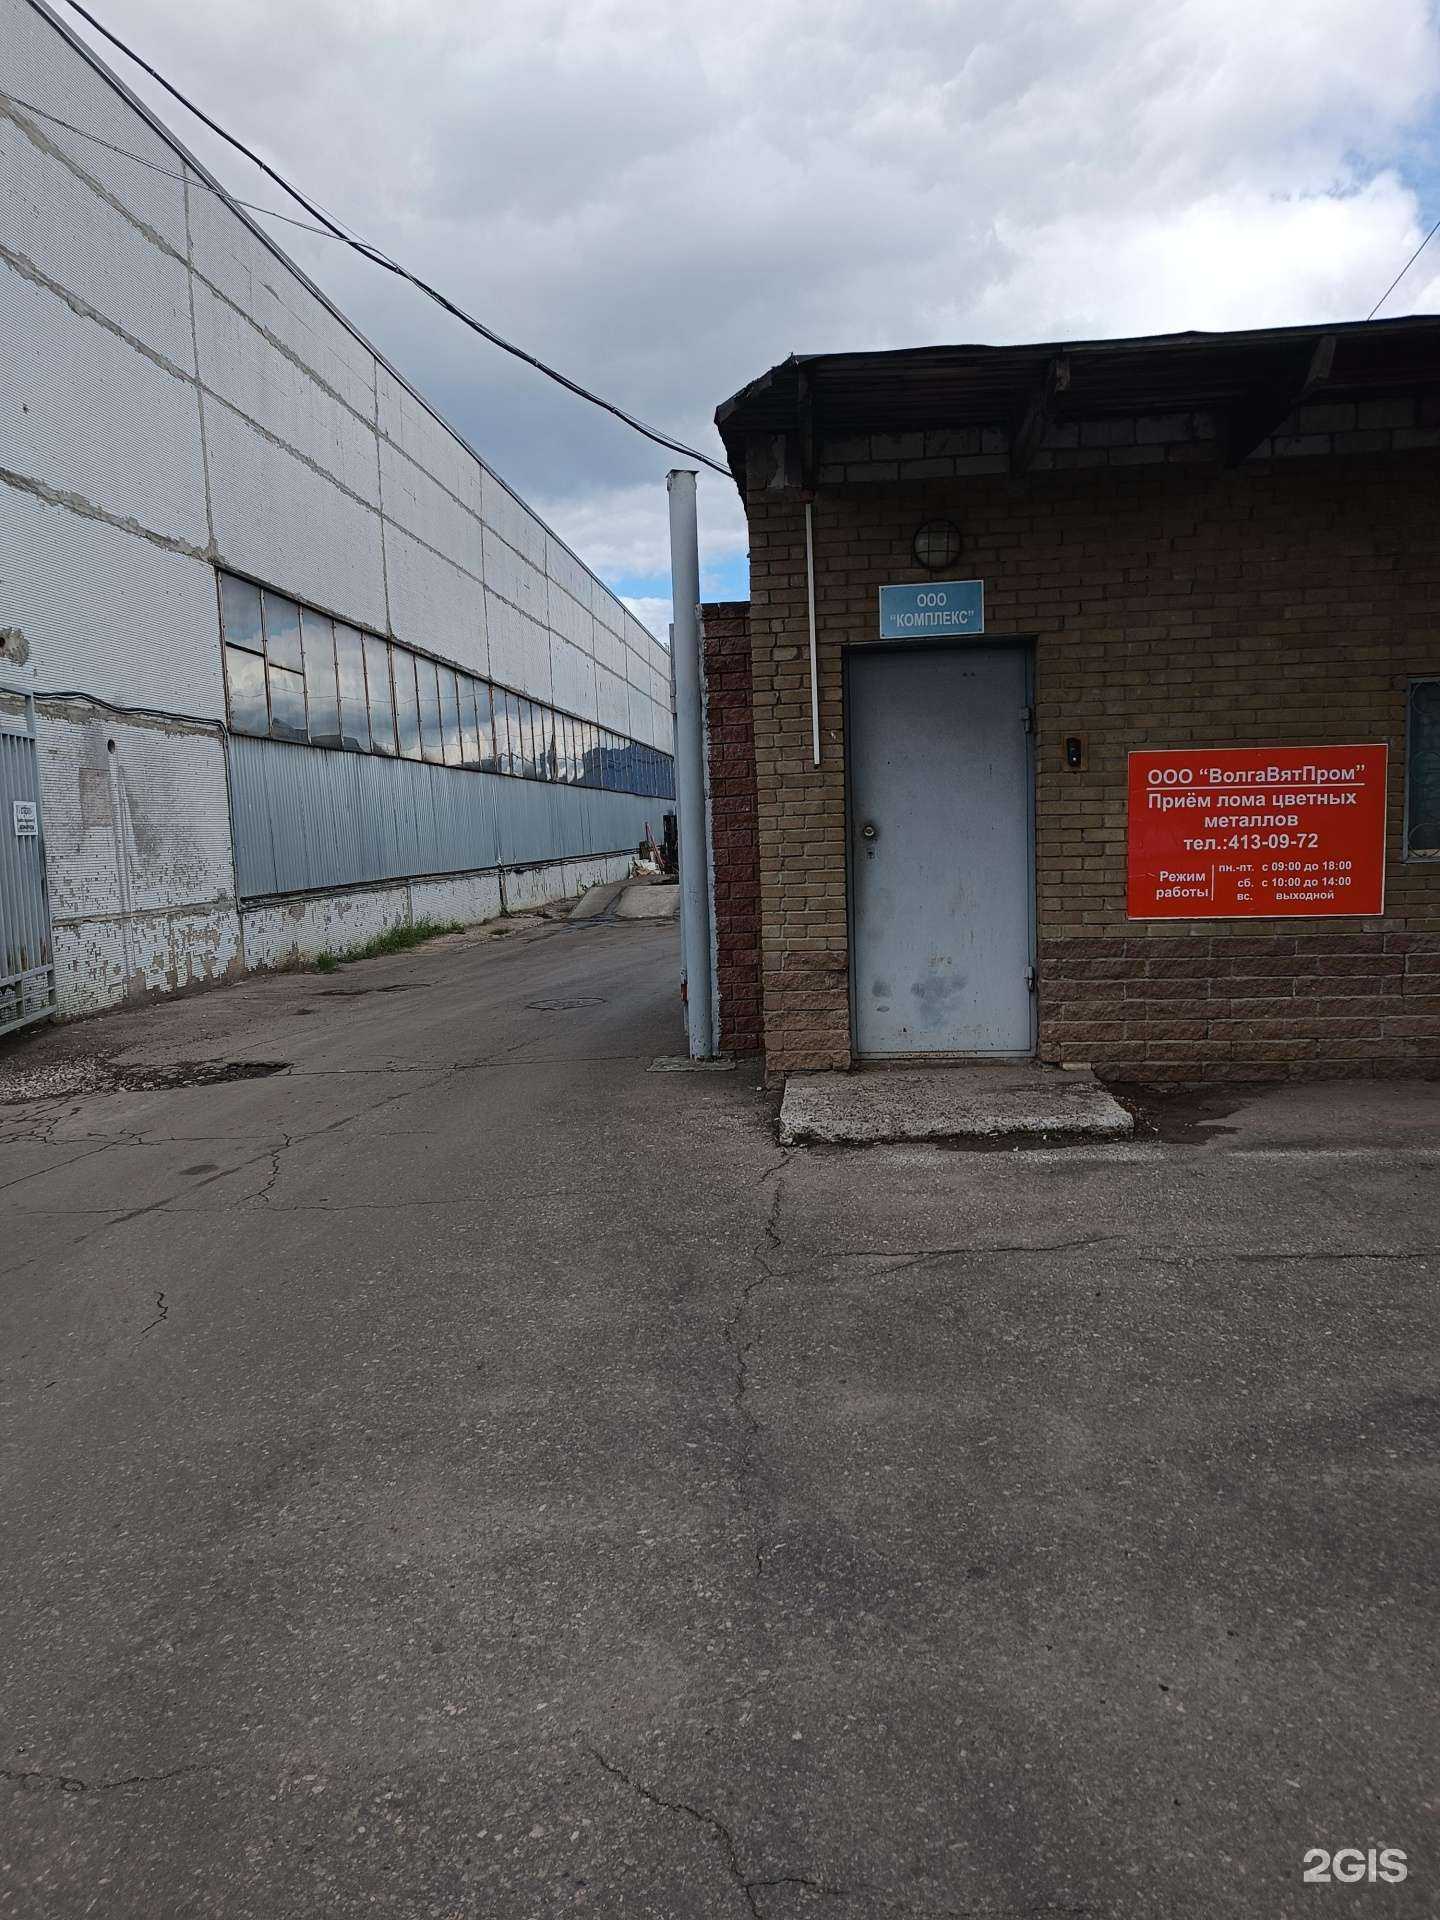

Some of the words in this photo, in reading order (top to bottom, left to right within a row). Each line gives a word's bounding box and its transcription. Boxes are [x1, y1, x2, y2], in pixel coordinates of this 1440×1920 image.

[917, 592, 947, 607] ООО
[1148, 768, 1193, 785] ООО
[1148, 792, 1211, 812] Приём
[1216, 794, 1266, 808] лома
[1272, 792, 1357, 809] цветных
[1204, 814, 1299, 828] металлов
[1184, 833, 1319, 851] тел.:413-09-72
[1262, 864, 1269, 872] с
[1271, 862, 1301, 871] 09:00
[1304, 862, 1319, 872] до
[1322, 861, 1352, 871] 18:00
[1159, 871, 1206, 882] Режим
[1237, 878, 1254, 888] сб.
[1261, 879, 1268, 887] с
[1272, 877, 1301, 887] 10:00
[1303, 878, 1319, 888] до
[1321, 876, 1352, 887] 14:00
[1156, 887, 1209, 900] работы
[1237, 893, 1253, 901] вс.
[1275, 890, 1335, 901] выходной
